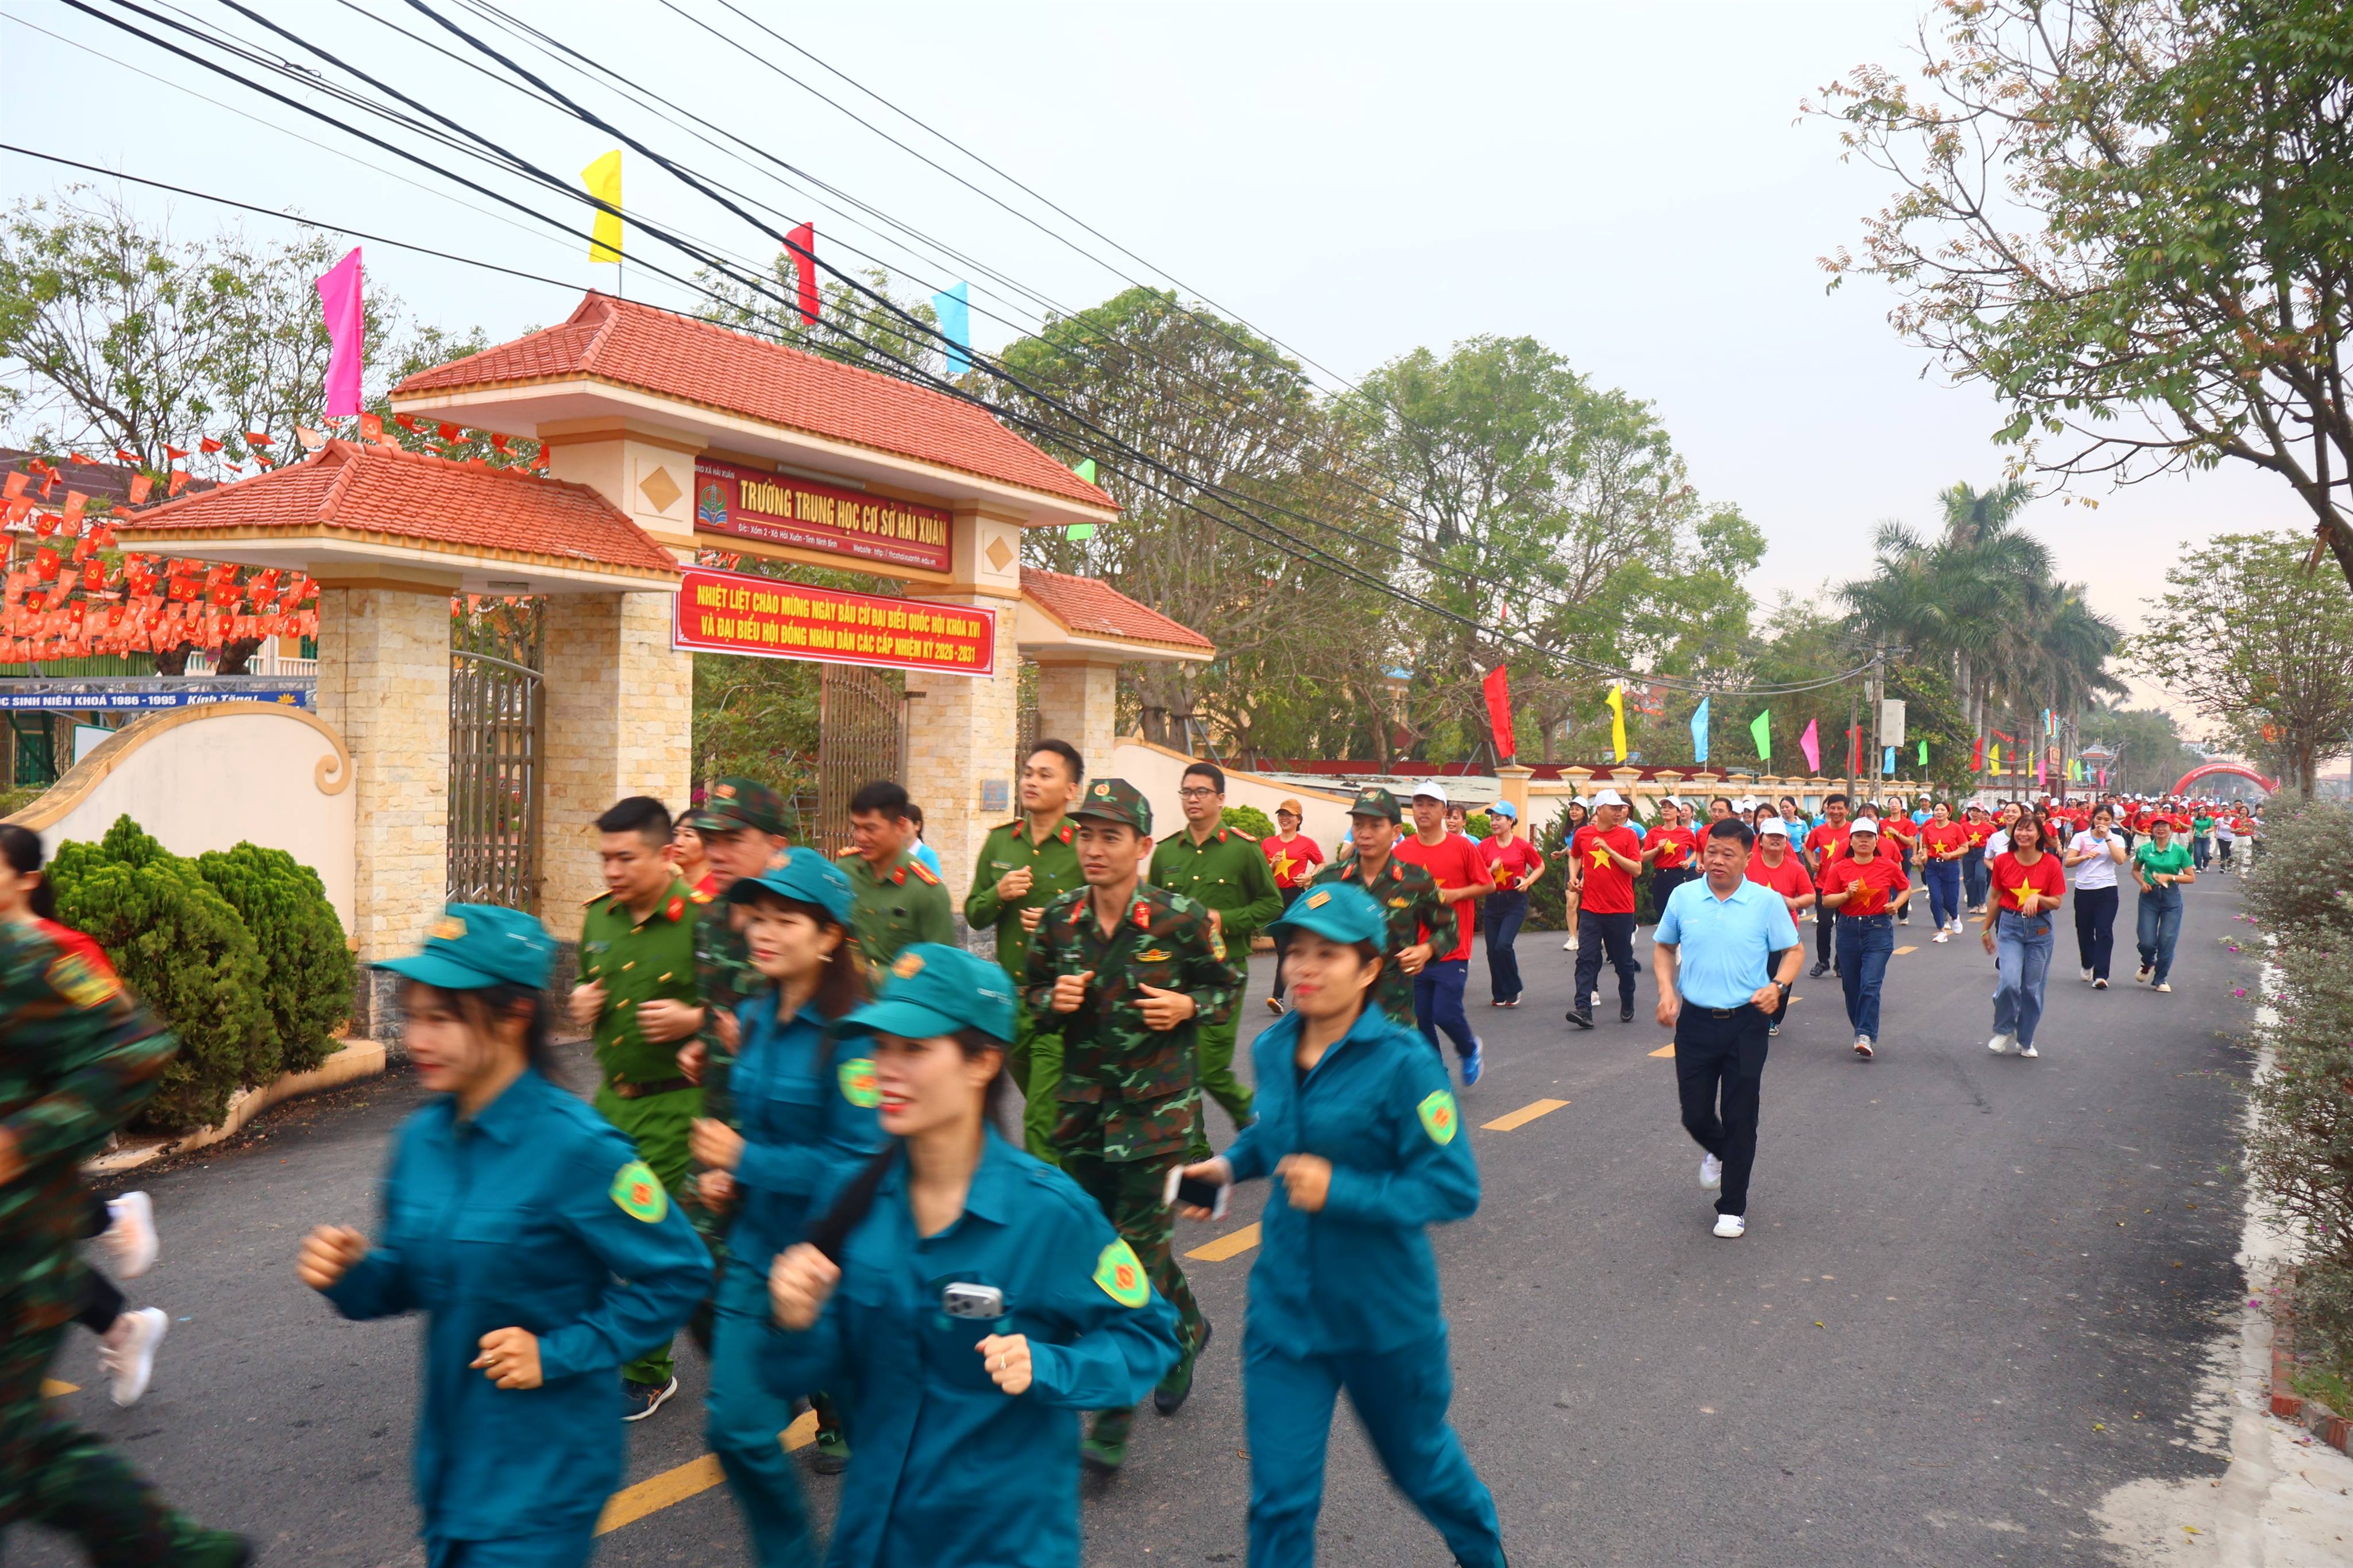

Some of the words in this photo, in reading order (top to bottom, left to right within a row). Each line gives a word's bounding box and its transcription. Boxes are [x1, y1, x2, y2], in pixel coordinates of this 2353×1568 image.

[739, 477, 792, 519] TRƯỜNG
[796, 491, 835, 526] TRUNG
[837, 500, 860, 536] HỌC
[863, 505, 879, 534] CƠ
[880, 502, 897, 538] SỞ
[898, 506, 916, 542] HẢI
[918, 513, 947, 547] XUÂN
[750, 525, 763, 535] Xóm
[816, 536, 827, 546] Ninh
[697, 583, 728, 612] NHIỆT
[730, 586, 751, 614] LIỆT
[753, 590, 779, 614] CHÀO
[781, 593, 809, 618] MỪNG
[812, 597, 836, 621] NGÀY
[838, 598, 857, 624] BẦU
[858, 601, 871, 625] CỬ
[871, 608, 886, 631] ĐẠI
[888, 605, 907, 630] BIỂU
[908, 609, 930, 633] QUỐC
[932, 613, 945, 638] HỘI
[947, 616, 966, 638] KHÓA
[968, 621, 981, 639] XVI
[701, 612, 715, 636] VÀ
[717, 617, 735, 643] ĐẠI
[737, 613, 760, 642] BIỂU
[762, 619, 779, 647] HỘI
[781, 619, 807, 646] ĐỒNG
[809, 626, 835, 649] NHÂN
[836, 628, 855, 651] DÂN
[857, 631, 875, 653] CÁC
[876, 631, 893, 655] CẤP
[894, 636, 921, 661] NHIỆM
[923, 638, 934, 659] KỲ
[12, 697, 40, 706] SINH
[43, 694, 72, 706] NIÊN
[74, 694, 107, 706] KHOÁ
[110, 696, 140, 706] 1986
[187, 694, 218, 705] Kính
